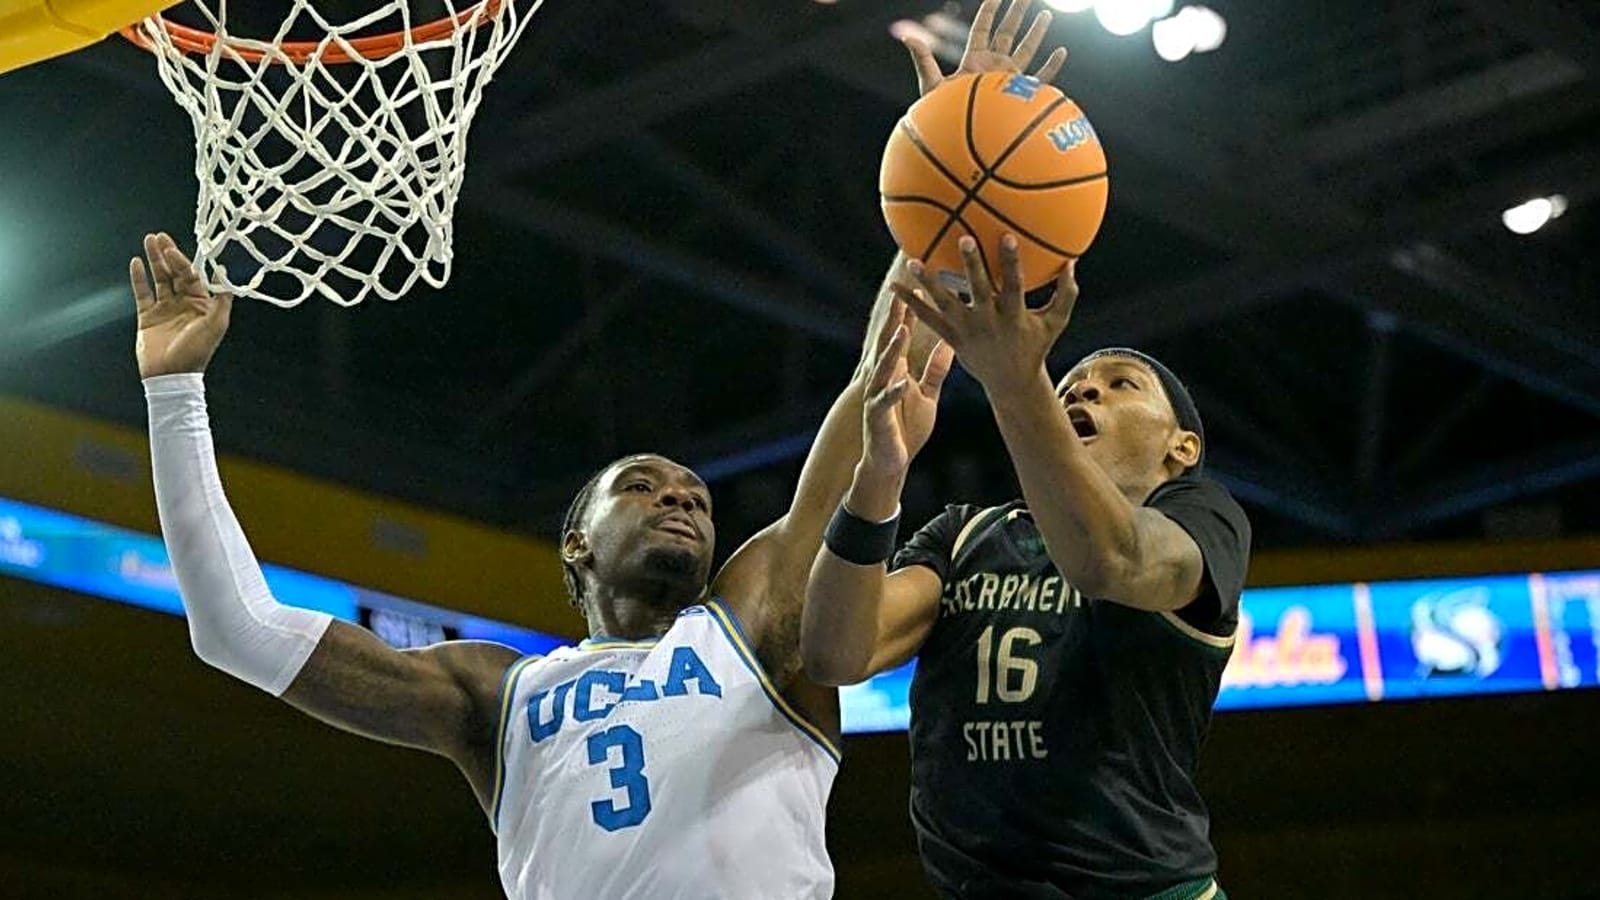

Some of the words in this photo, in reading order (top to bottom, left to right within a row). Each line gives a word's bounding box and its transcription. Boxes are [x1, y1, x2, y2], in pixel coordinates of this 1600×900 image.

[527, 646, 722, 743] UCLA
[976, 626, 1042, 703] 16
[587, 725, 651, 832] 3
[963, 721, 1048, 761] STATE
